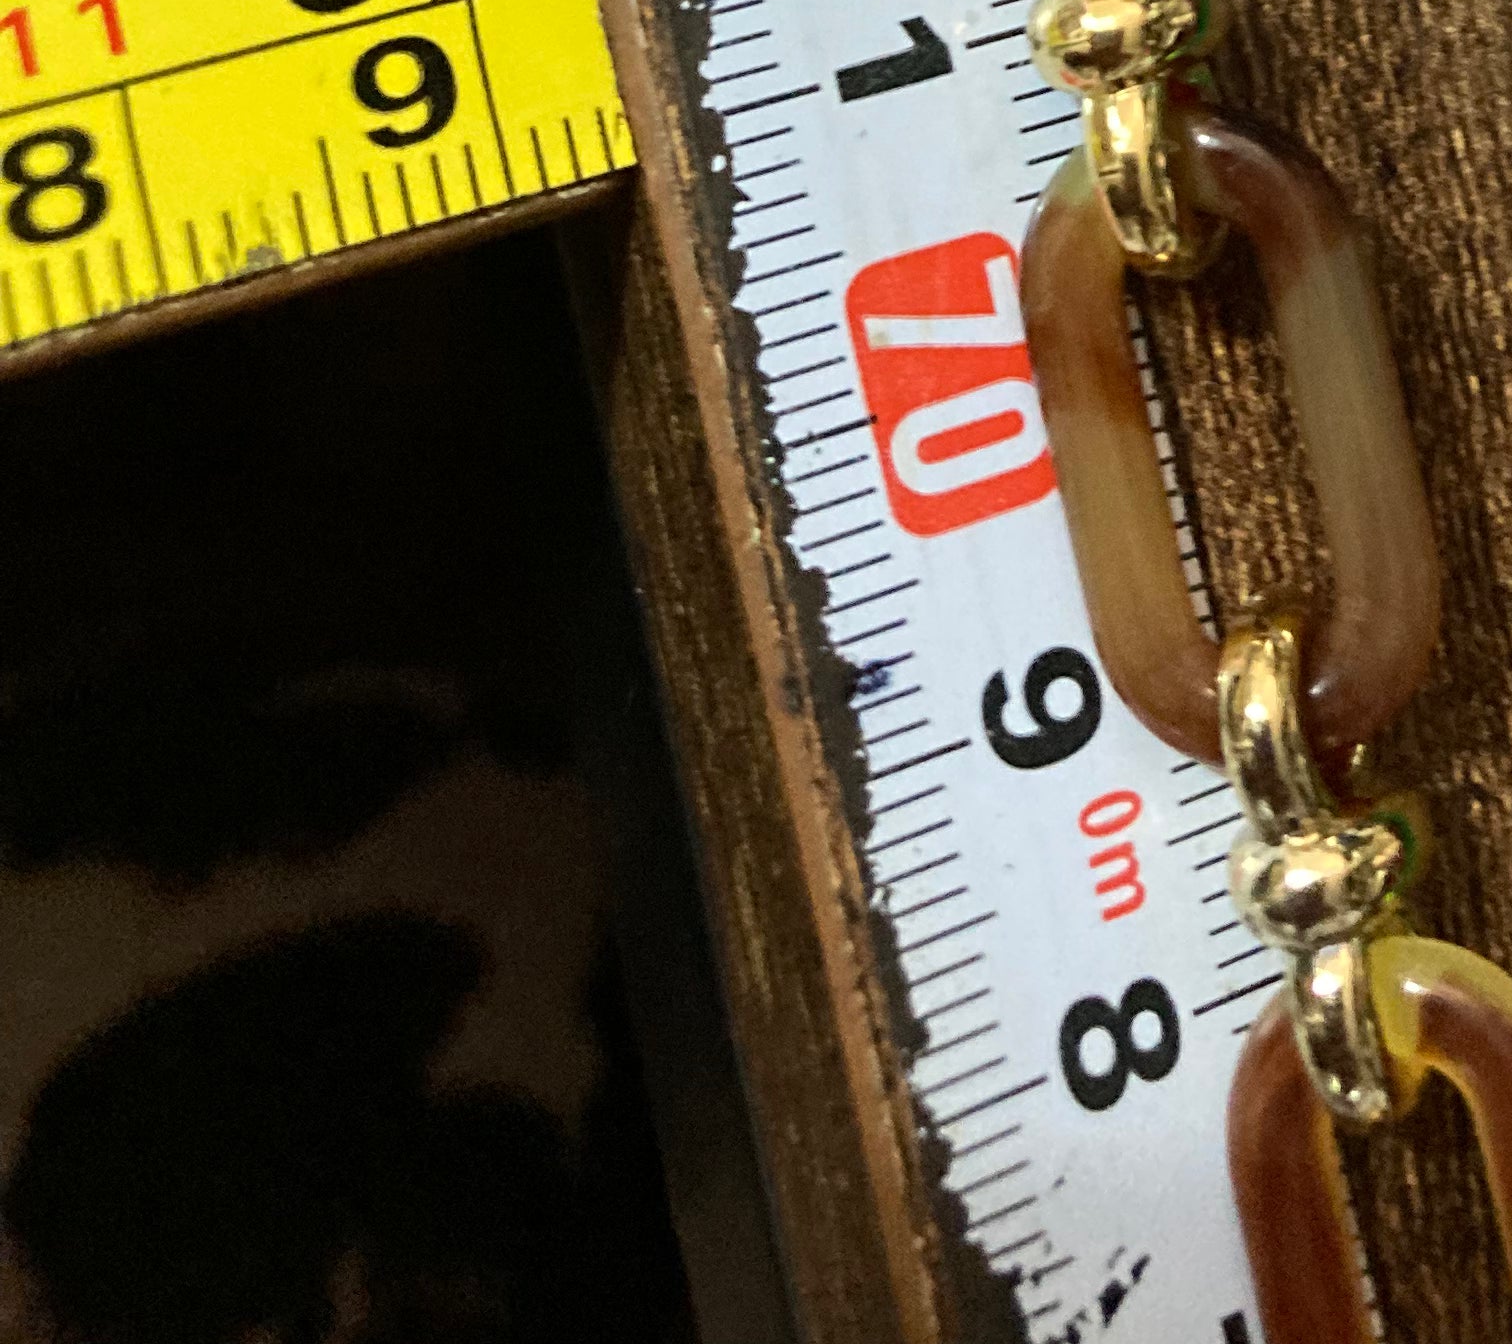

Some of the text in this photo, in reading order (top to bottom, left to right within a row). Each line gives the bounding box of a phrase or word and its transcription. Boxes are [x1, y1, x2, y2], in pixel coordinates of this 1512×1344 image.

[352, 36, 457, 149] 9
[835, 16, 954, 102] 1
[1, 126, 111, 244] 8
[863, 255, 1048, 496] 70
[981, 646, 1102, 770] 9
[1079, 788, 1147, 922] 0m
[1059, 977, 1180, 1112] 8
